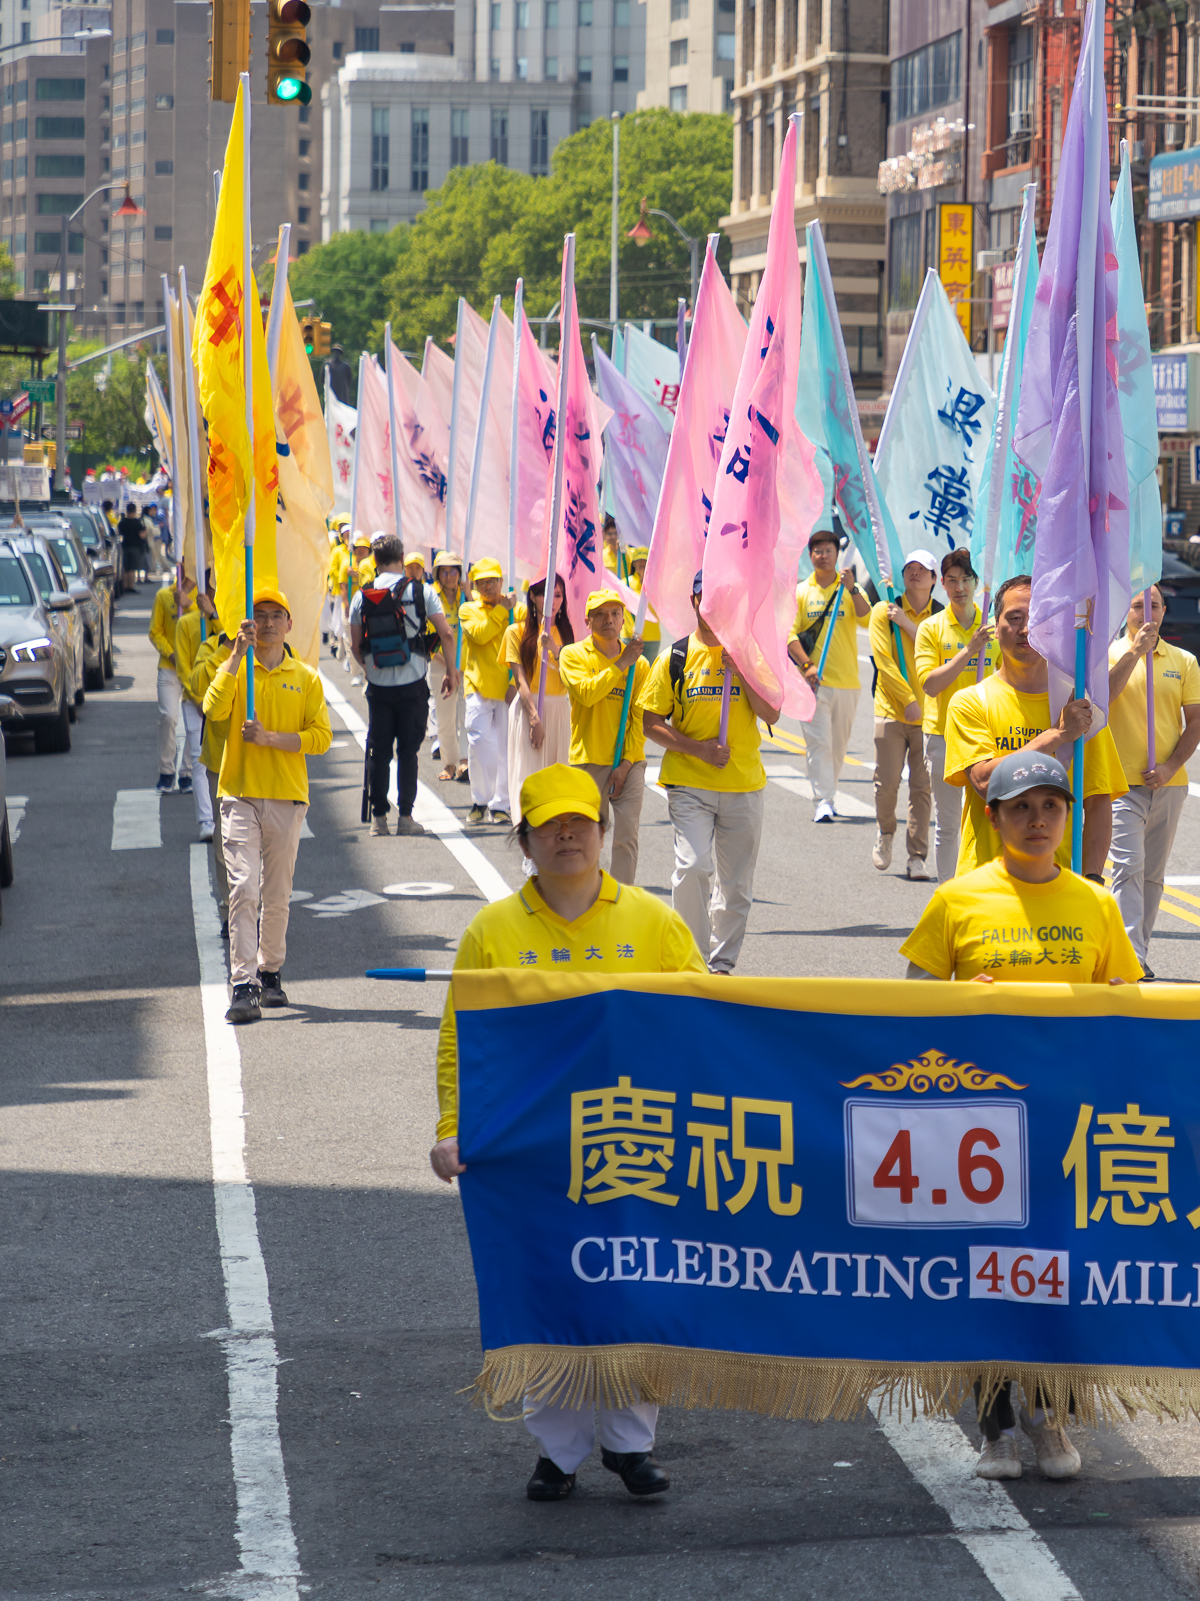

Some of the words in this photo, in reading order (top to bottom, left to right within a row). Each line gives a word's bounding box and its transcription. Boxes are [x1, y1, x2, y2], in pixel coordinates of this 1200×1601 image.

[996, 737, 1031, 751] FALU
[982, 926, 1034, 945] FALUN
[1037, 925, 1084, 942] GONG
[518, 943, 635, 966] 法輪大法
[983, 946, 1083, 970] 法輪大法
[566, 1076, 802, 1216] 慶祝
[873, 1127, 1005, 1207] 4.6
[571, 1236, 960, 1301] CELEBRATING
[975, 1251, 1065, 1300] 464
